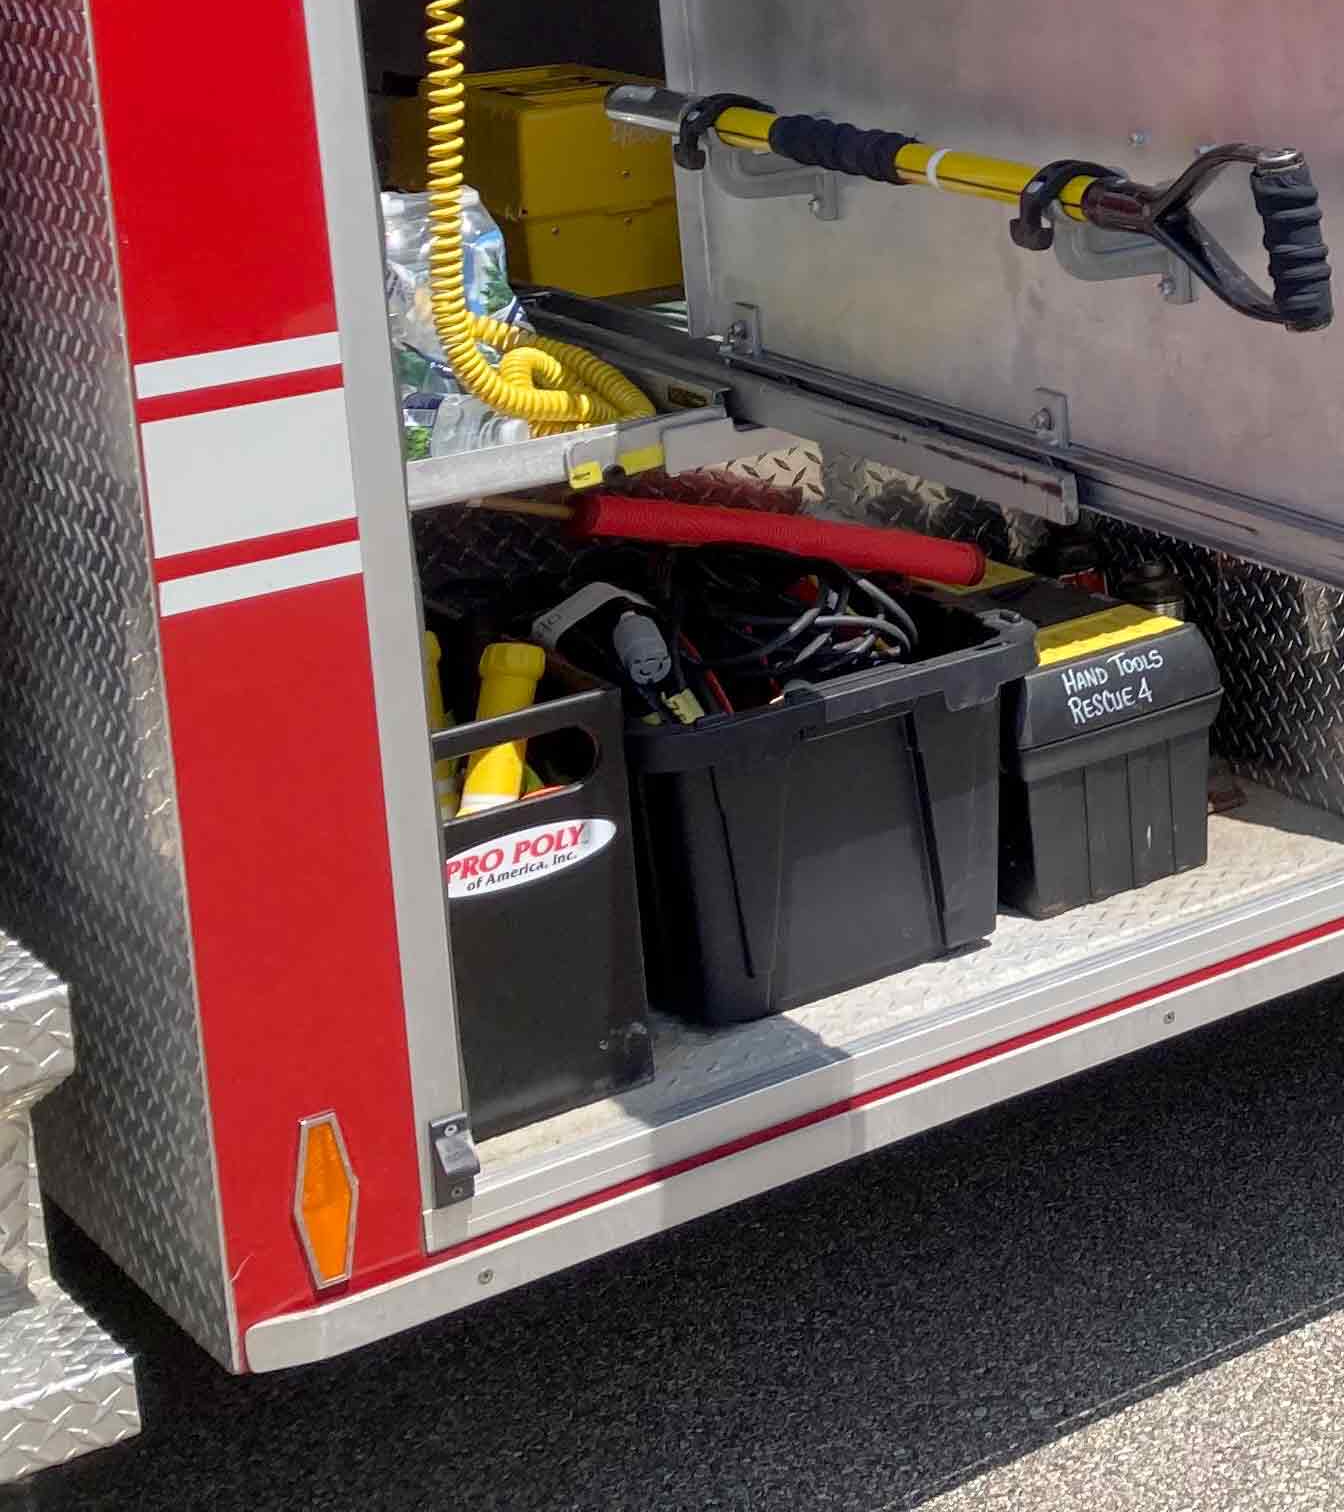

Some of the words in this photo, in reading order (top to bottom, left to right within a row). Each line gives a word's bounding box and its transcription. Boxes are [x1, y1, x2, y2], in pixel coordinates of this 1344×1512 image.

[1061, 667, 1108, 696] HAND
[1106, 649, 1164, 677] TOOLS
[1067, 686, 1136, 724] RESCUE
[1138, 676, 1153, 703] 4
[446, 847, 505, 885] PRO
[512, 822, 586, 864] POLY
[466, 876, 482, 892] of
[552, 851, 577, 866] Inc.
